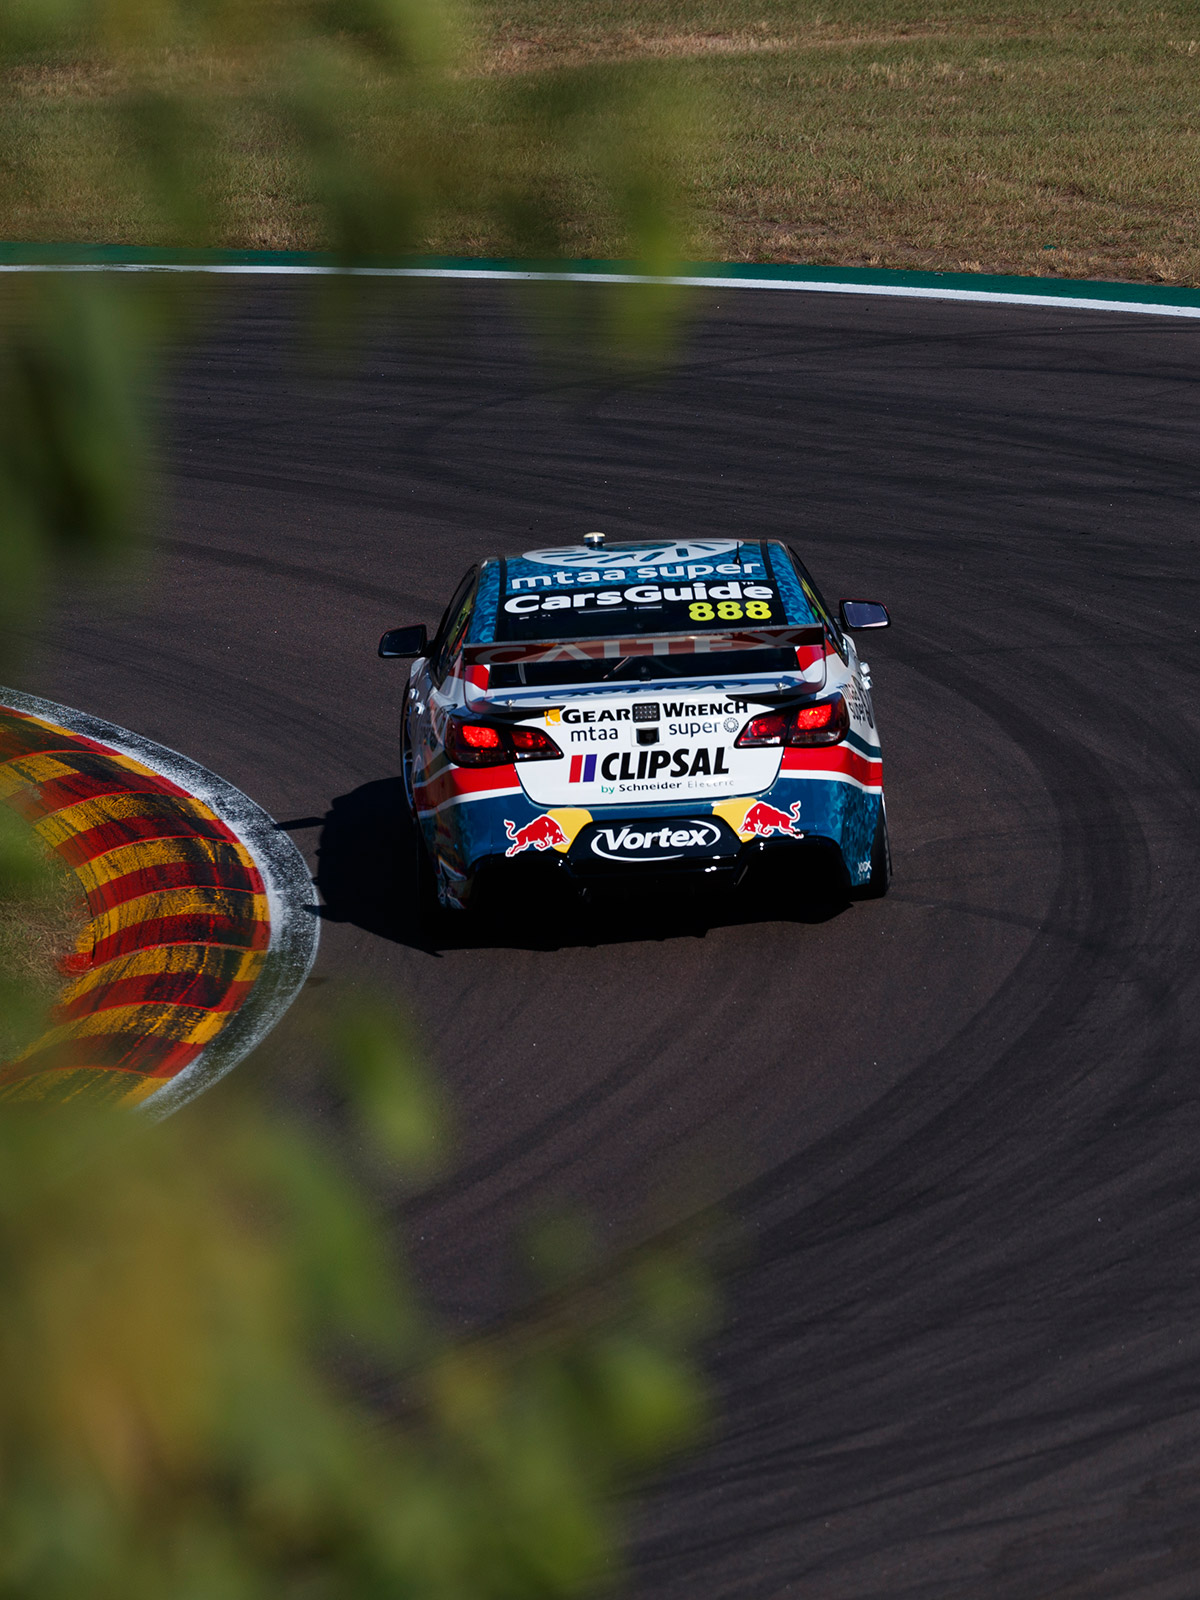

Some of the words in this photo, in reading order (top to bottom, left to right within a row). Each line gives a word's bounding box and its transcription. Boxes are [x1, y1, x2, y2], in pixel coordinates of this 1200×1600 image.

[511, 569, 626, 589] mtaa
[637, 563, 761, 580] super
[504, 582, 774, 614] CarsGuide
[688, 601, 772, 621] 888
[562, 709, 631, 724] GEAR
[663, 702, 748, 718] WRENCH
[571, 727, 619, 742] mtaa
[669, 721, 720, 738] super
[601, 747, 729, 781] CLIPSAL
[601, 785, 615, 794] by
[619, 782, 682, 792] Schneider
[596, 827, 710, 851] Vortex
